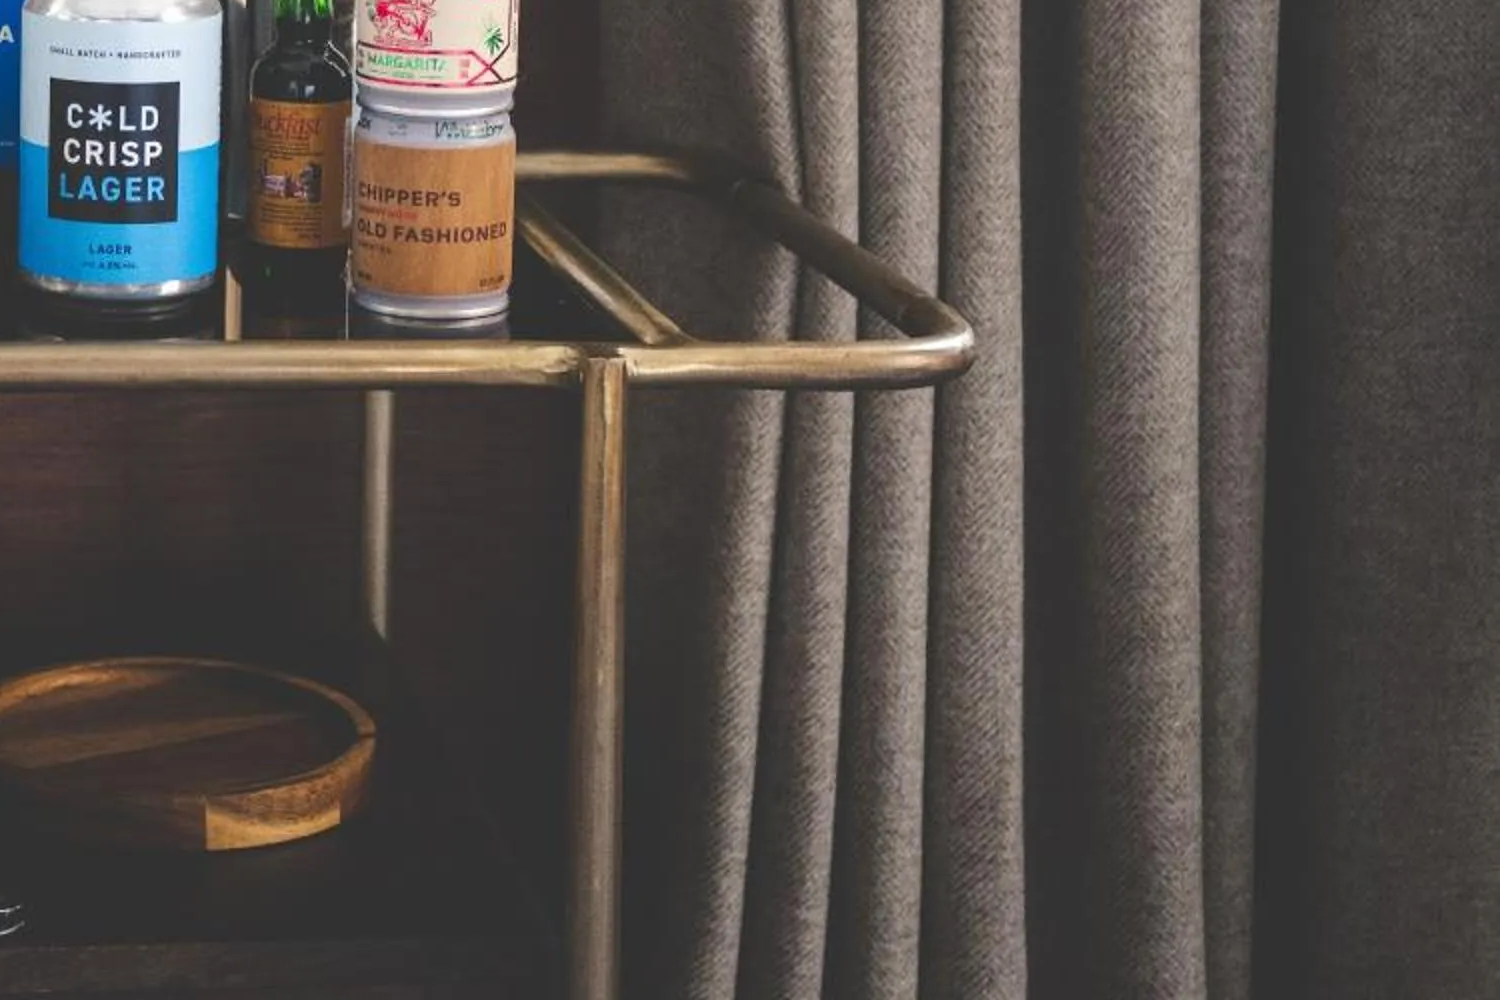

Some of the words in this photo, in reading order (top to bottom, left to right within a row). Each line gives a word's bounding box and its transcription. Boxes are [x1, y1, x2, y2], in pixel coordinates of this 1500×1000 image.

[77, 49, 107, 59] BATCH
[63, 137, 164, 168] CRISP
[59, 173, 166, 202] LAGER
[357, 183, 462, 208] CHIPPER'S
[357, 218, 387, 239] OLD
[393, 221, 507, 244] FASHIONED
[88, 243, 133, 255] LAGER
